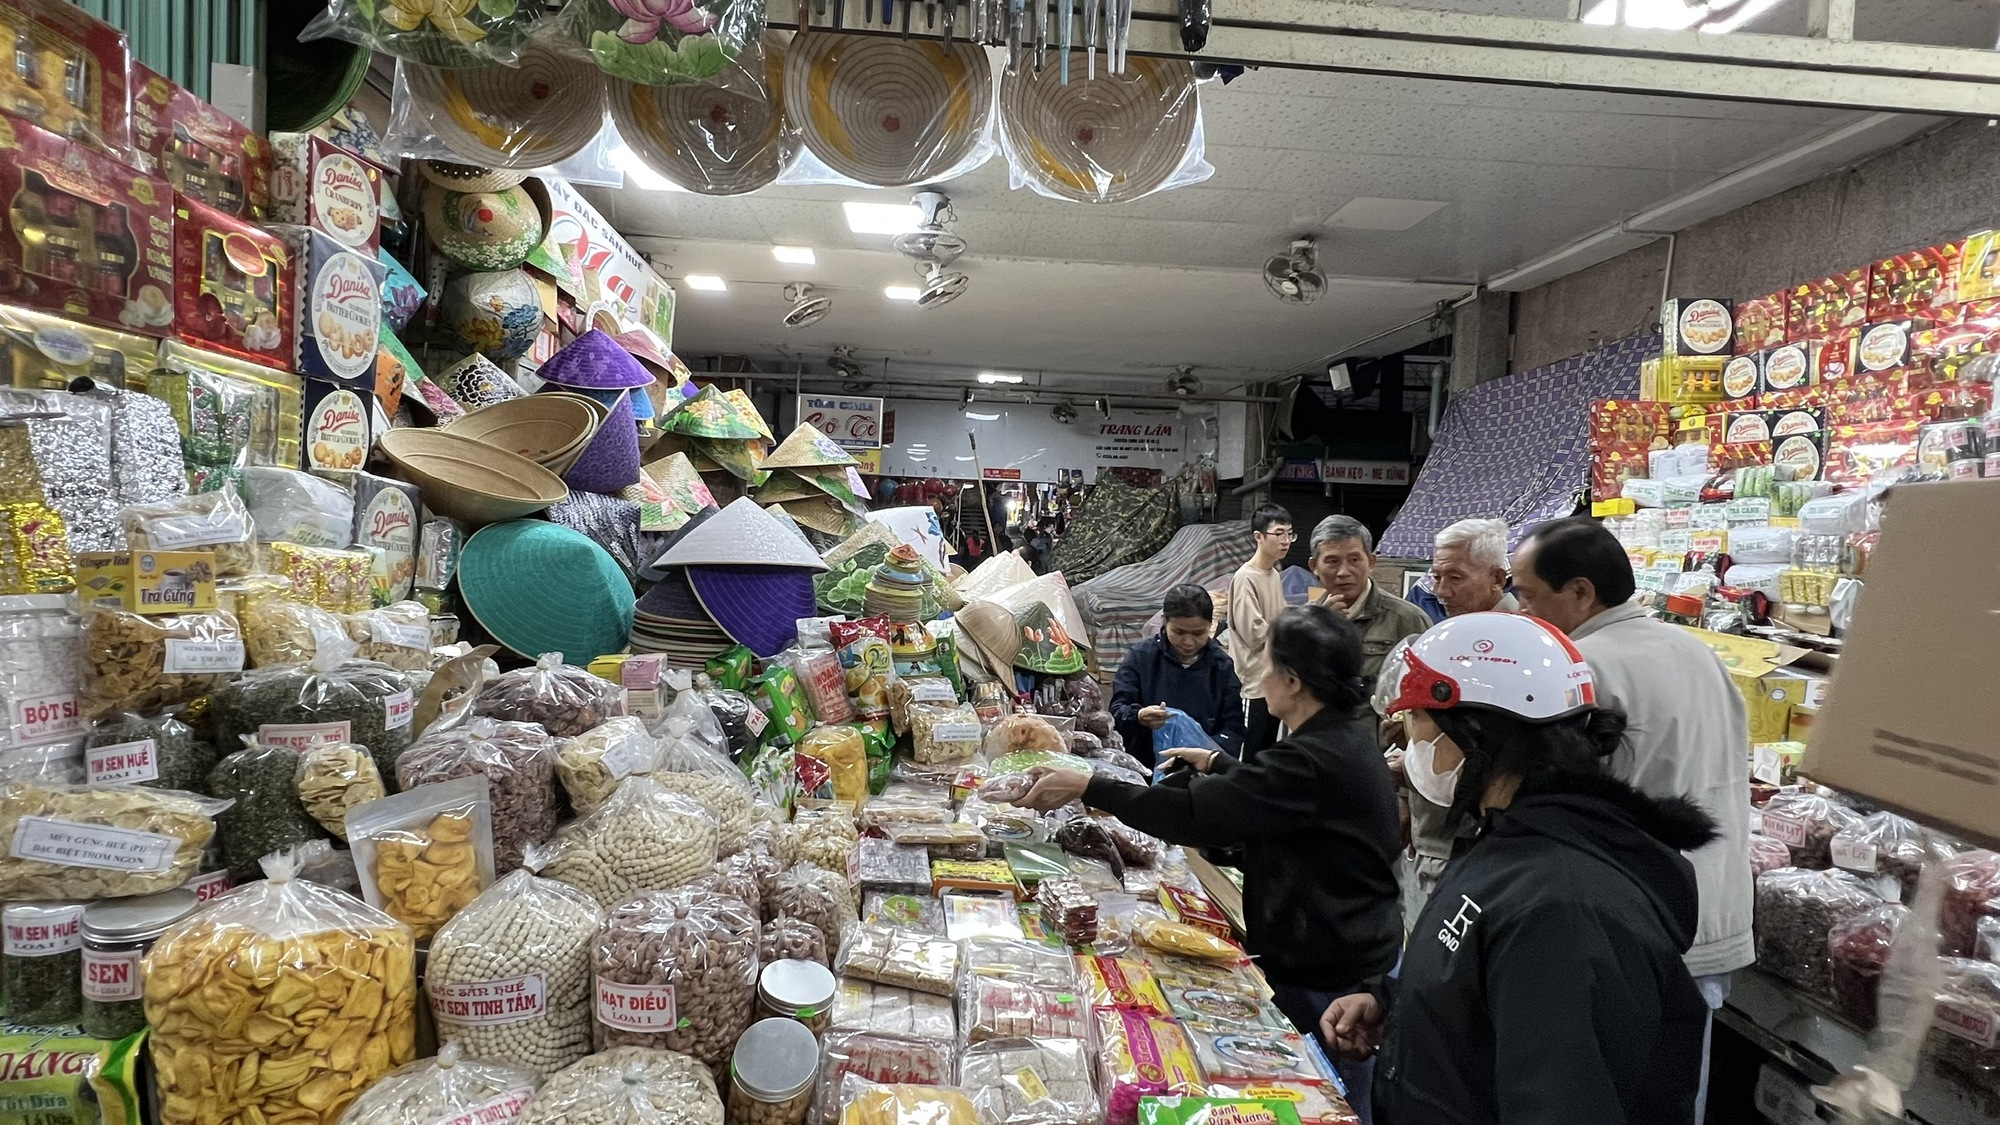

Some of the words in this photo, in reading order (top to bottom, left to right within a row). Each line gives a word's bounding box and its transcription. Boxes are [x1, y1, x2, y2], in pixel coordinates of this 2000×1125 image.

[322, 168, 364, 192] Danisa
[325, 187, 362, 211] CRANBERRY
[326, 274, 371, 303] Danisa
[320, 409, 360, 432] Danisa
[1099, 424, 1143, 435] TRANG
[371, 510, 409, 537] Danisa
[79, 557, 111, 569] Ginger
[24, 701, 59, 725] BỘT
[91, 759, 104, 774] TIM
[105, 756, 125, 771] SEN
[127, 745, 149, 768] HUẾ
[114, 855, 144, 864] NGON
[7, 925, 24, 940] TIM
[26, 924, 49, 941] SEN
[53, 913, 79, 938] HUẾ
[1438, 928, 1460, 952] GND
[88, 962, 130, 984] SEN
[448, 1000, 470, 1016] SEN
[472, 999, 504, 1019] TỊNH
[506, 993, 537, 1013] TÂM
[601, 988, 625, 1011] HẠT
[629, 990, 667, 1011] ĐIỀU
[1211, 1103, 1237, 1117] Bánh
[1232, 1112, 1270, 1125] Nướng
